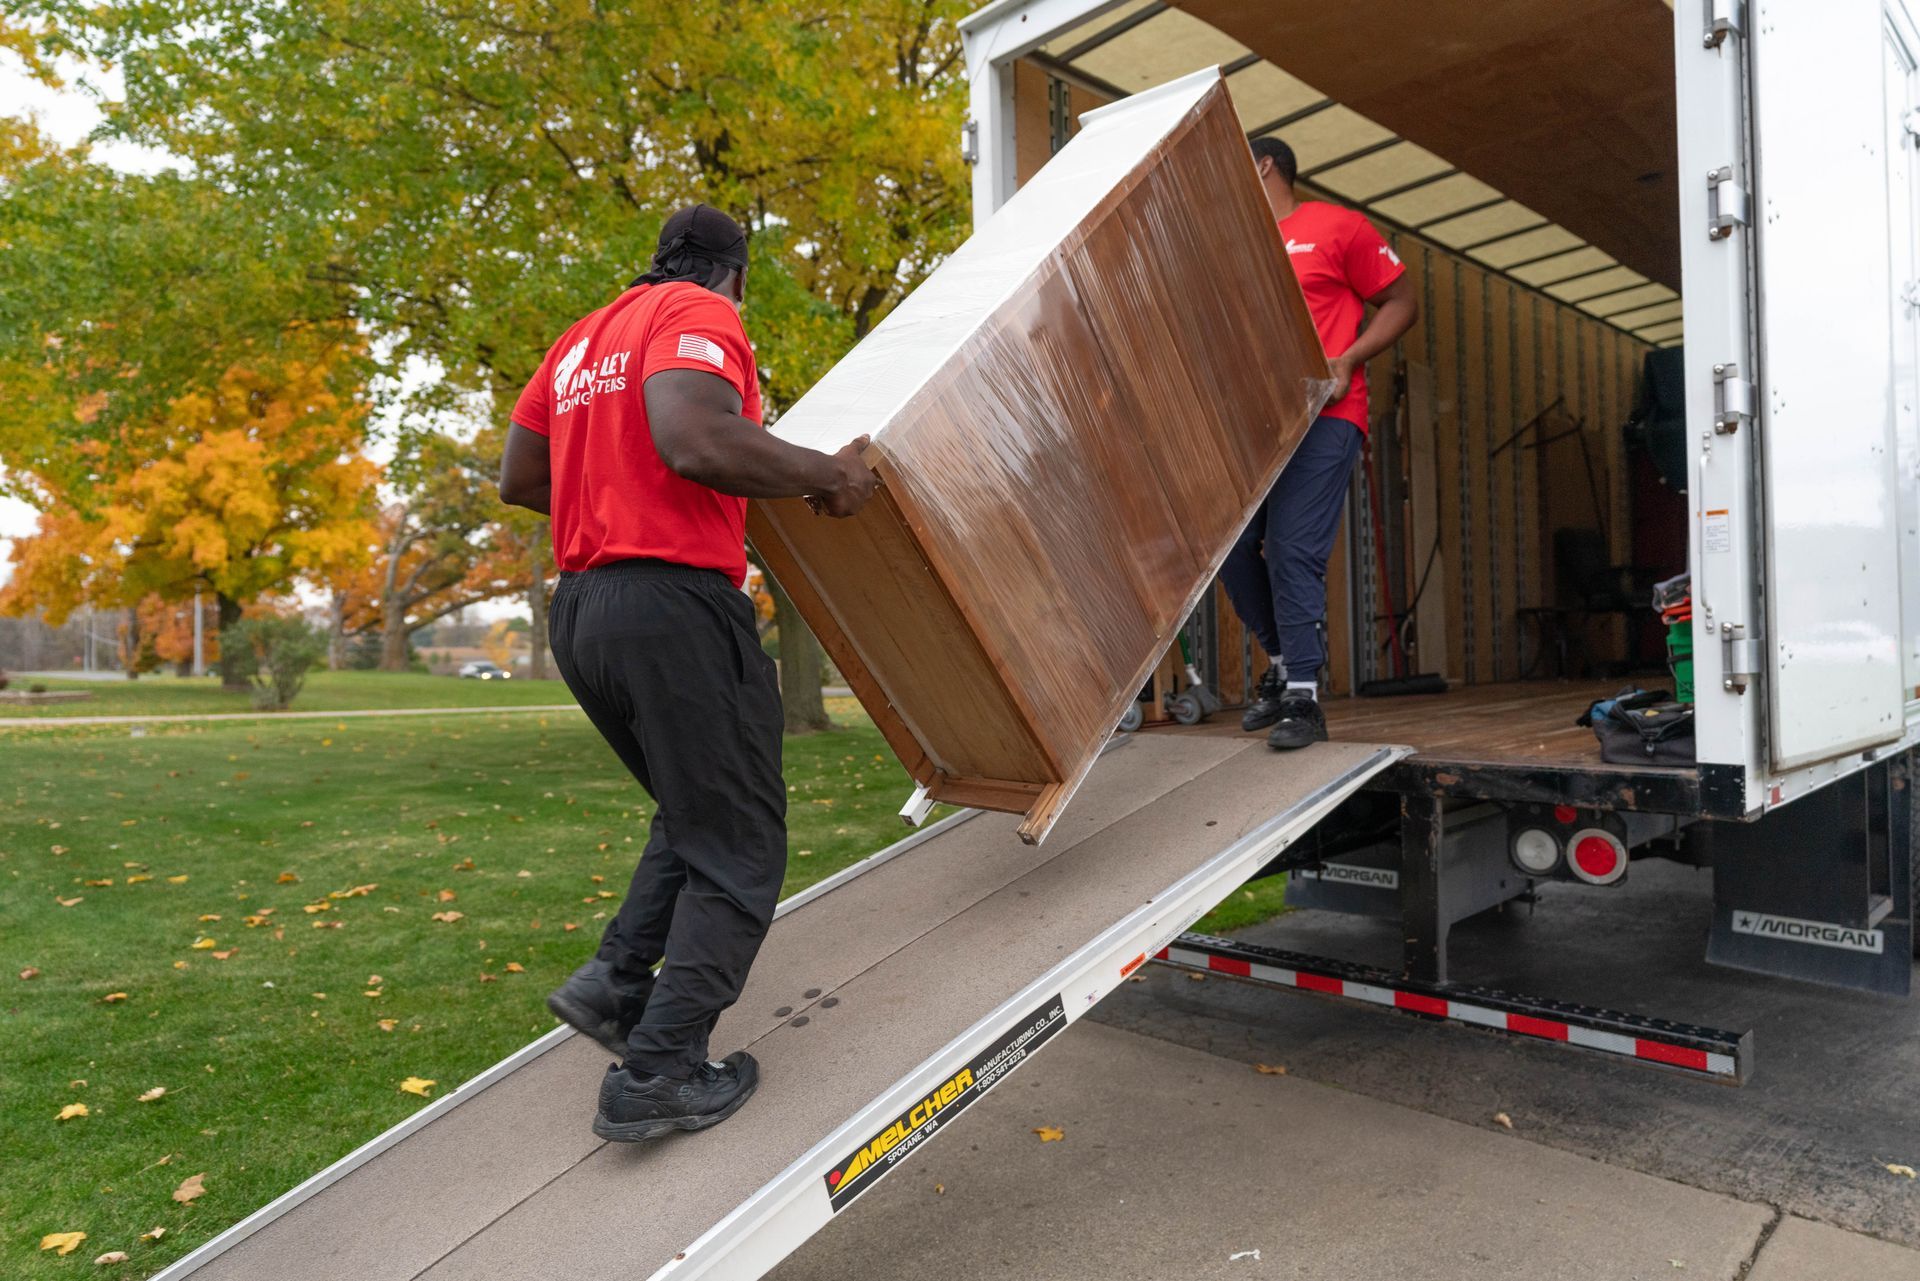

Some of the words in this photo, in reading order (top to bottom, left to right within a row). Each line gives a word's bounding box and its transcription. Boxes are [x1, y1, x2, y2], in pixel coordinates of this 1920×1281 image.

[1326, 867, 1393, 885] MORGAN
[1761, 919, 1876, 948] MORGAN
[860, 1068, 975, 1170] MELCHER
[976, 1027, 1035, 1078] MANUFACTURING
[1049, 1005, 1062, 1019] INC.
[887, 1131, 925, 1164] SPOKANE,
[925, 1119, 938, 1135] WA
